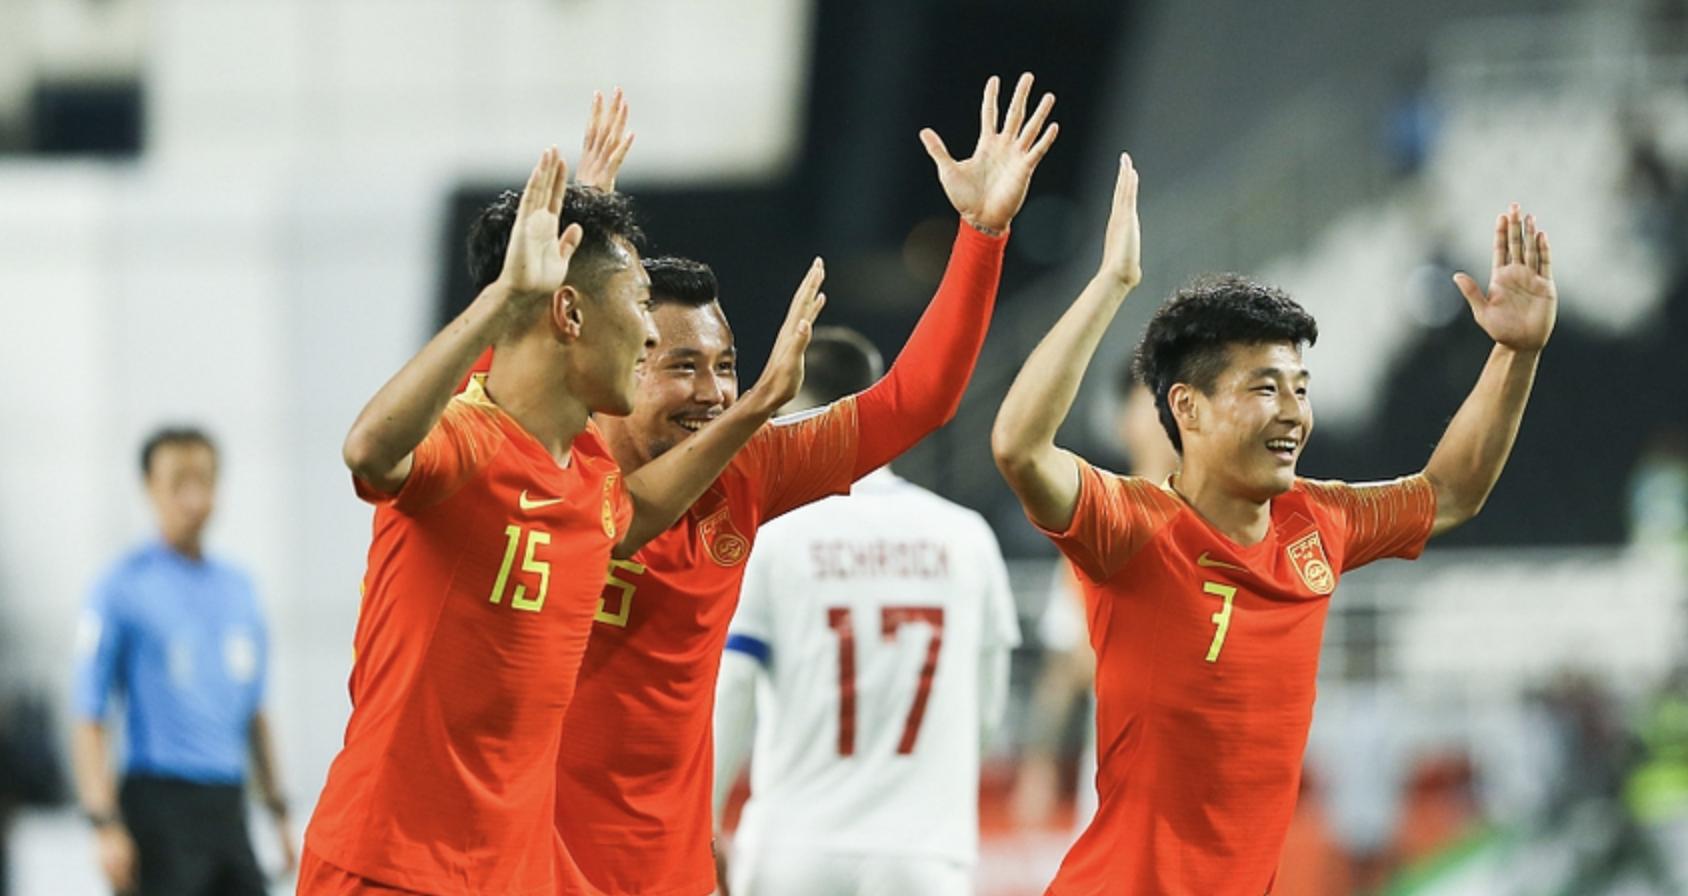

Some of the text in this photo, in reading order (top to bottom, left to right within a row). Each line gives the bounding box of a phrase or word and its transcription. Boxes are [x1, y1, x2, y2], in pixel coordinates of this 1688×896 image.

[489, 525, 551, 613] 15
[594, 559, 645, 627] 5
[810, 540, 951, 578] SCHROCK
[1203, 581, 1237, 662] 7
[827, 607, 943, 756] 17
